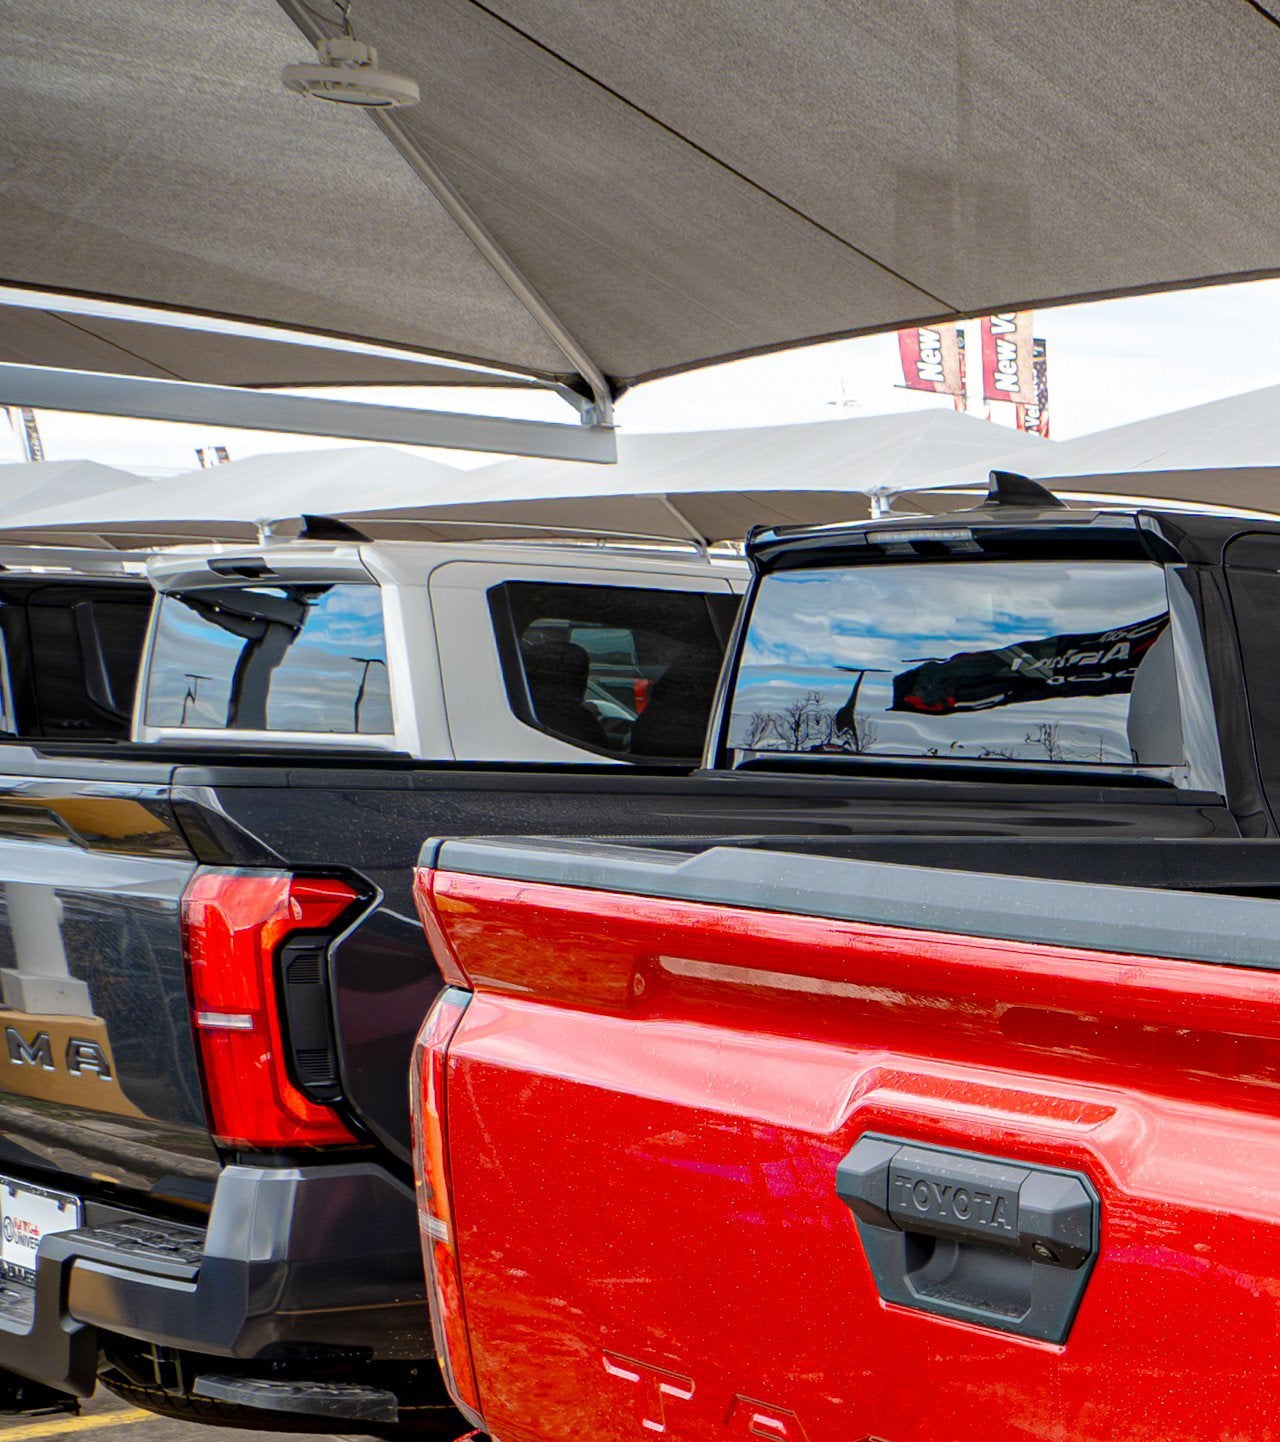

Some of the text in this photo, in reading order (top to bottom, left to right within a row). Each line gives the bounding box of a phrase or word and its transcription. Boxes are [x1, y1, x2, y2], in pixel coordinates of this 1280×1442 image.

[917, 327, 945, 382] New
[994, 338, 1021, 393] New
[894, 1175, 1013, 1230] TOYOTA
